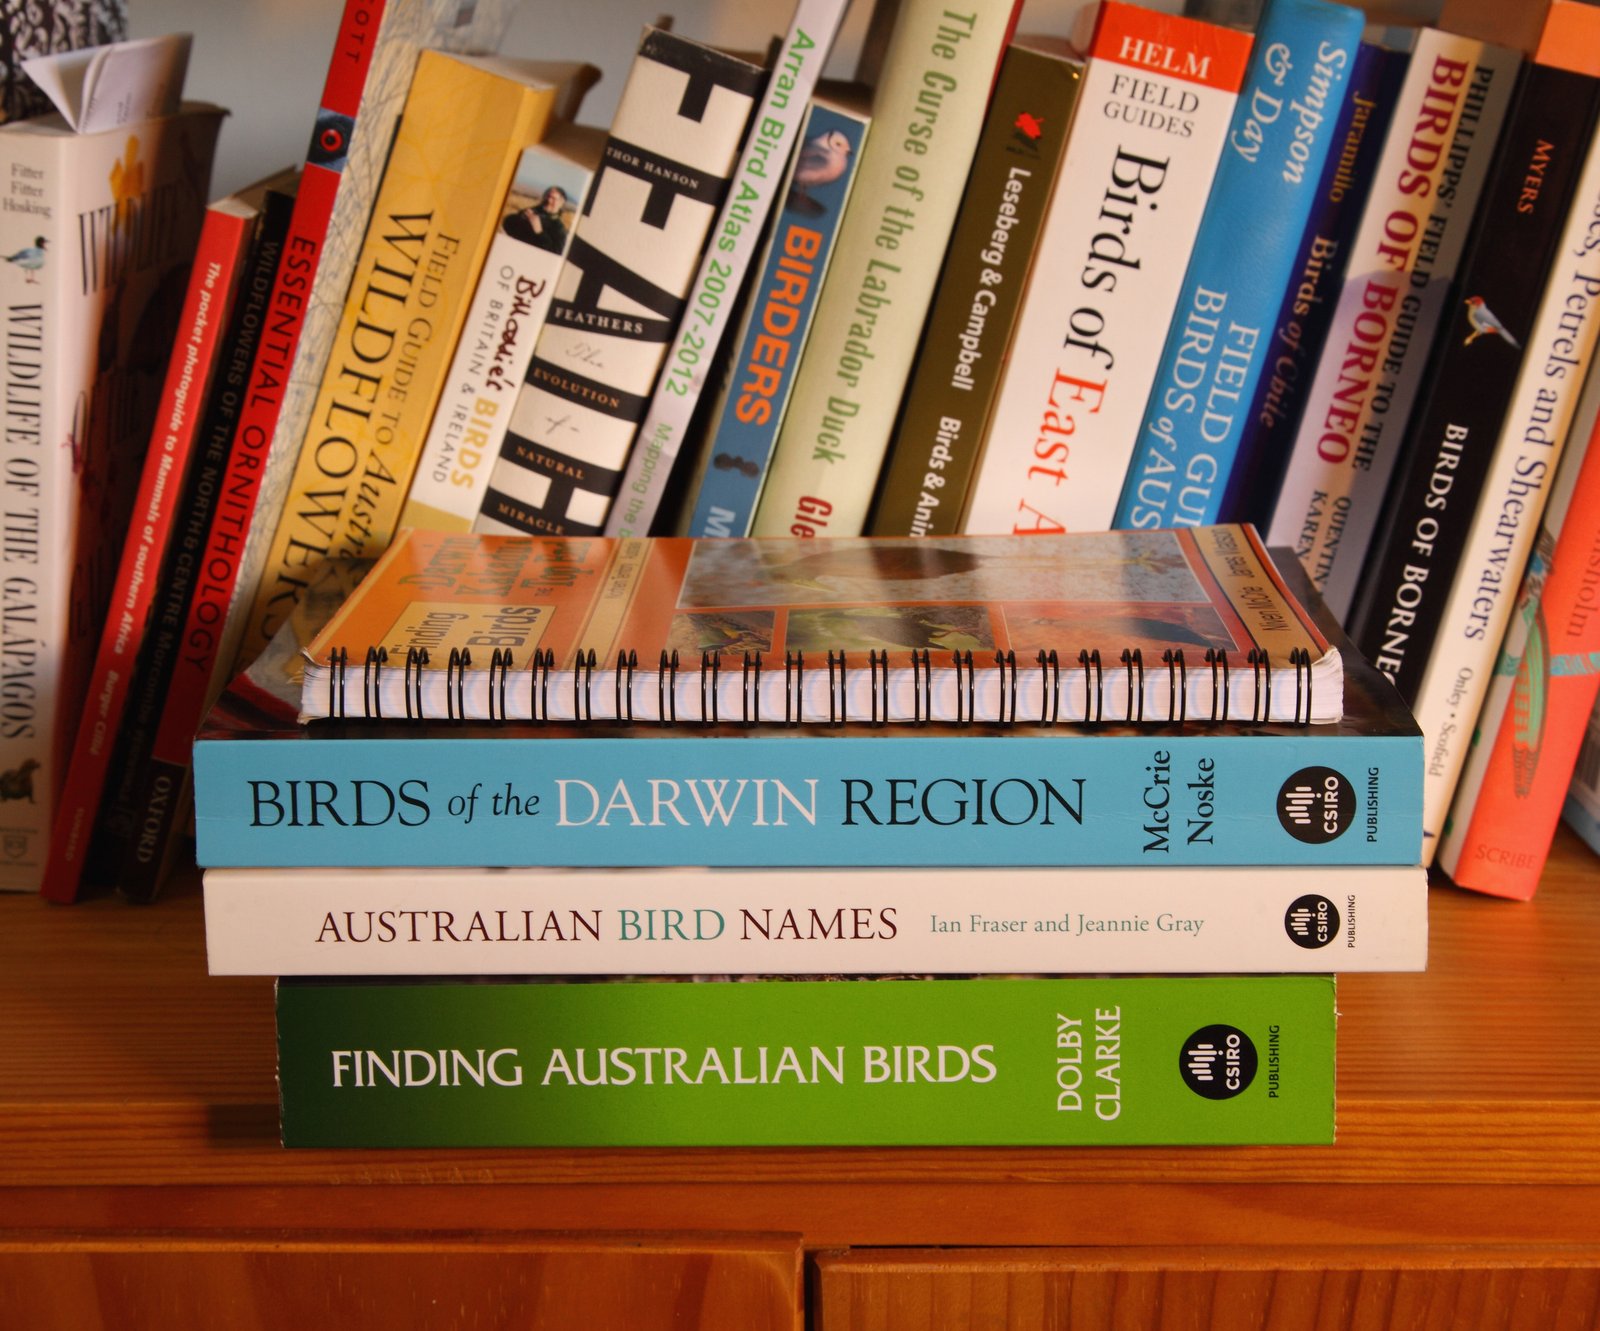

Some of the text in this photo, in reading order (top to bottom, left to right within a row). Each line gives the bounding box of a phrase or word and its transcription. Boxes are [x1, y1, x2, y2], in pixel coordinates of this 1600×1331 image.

[346, 0, 374, 64] OTT
[931, 9, 978, 60] The
[1119, 36, 1212, 80] HELM
[903, 70, 957, 156] Curse
[1103, 100, 1195, 138] GUIDES
[1109, 73, 1200, 114] FIELD
[1231, 43, 1292, 163] & Day
[1283, 41, 1347, 185] Simpson
[606, 146, 700, 190] THOR HANSON
[892, 165, 924, 202] of
[1329, 91, 1376, 203] Jaramillo
[1517, 139, 1555, 214] MYERS
[665, 28, 815, 397] Arran Bird Atlas 2007-2012
[875, 205, 915, 250] the
[1081, 144, 1170, 293] Birds
[952, 167, 1031, 391] Leseberg & Campbell
[1317, 54, 1469, 464] BIRDS OF BORNEO
[1409, 213, 1448, 289] FIELD
[228, 241, 279, 385] WILDFLOWERS
[555, 306, 644, 334] FEATHERS
[735, 225, 823, 426] BIRDERS
[837, 258, 902, 388] Labrador
[1063, 307, 1114, 370] of
[1164, 284, 1227, 413] BIRDS
[1259, 234, 1338, 428] Birds of Chile
[1382, 292, 1422, 375] GUIDE
[1545, 270, 1600, 379] Petrels
[222, 391, 237, 419] OF
[433, 264, 516, 483] OF BRITAIN & IRELAND
[533, 367, 620, 409] EVOLUTION
[1200, 321, 1260, 443] FIELD
[1370, 381, 1398, 412] TO
[184, 235, 317, 673] ESSENTIAL ORNITHOLOGY
[207, 424, 229, 462] THE
[376, 411, 402, 446] TO
[450, 397, 498, 489] BIRDS
[811, 395, 861, 465] Duck
[929, 416, 963, 470] Birds
[1028, 368, 1108, 486] East
[1150, 416, 1177, 453] of
[1352, 418, 1384, 471] THE
[1524, 388, 1559, 447] and
[114, 262, 222, 655] The pocket photoguide to Mammals of southern Africa
[516, 446, 585, 480] NATURAL
[631, 422, 673, 496] Mapping
[923, 471, 946, 490] &
[1, 303, 47, 740] WILDLIFE OF THE GALÁPAGOS
[498, 503, 564, 536] MIRACLE
[624, 496, 646, 525] the
[1297, 489, 1328, 560] KAREN
[1314, 495, 1352, 585] QUENTIN
[1375, 422, 1470, 687] BIRDS OF BORNE
[1464, 455, 1548, 641] Shearwaters
[465, 606, 542, 648] Birds
[1428, 667, 1474, 778] Onley Scofield
[137, 776, 172, 863] OXFORD
[247, 778, 1087, 827] BIRDS of the DARWIN REGION
[1142, 750, 1171, 854] McCrie
[1186, 757, 1215, 846] Noske
[1323, 776, 1339, 834] CSIRO
[1367, 767, 1379, 843] PUBLISHING
[1475, 842, 1539, 869] SCRIBE
[314, 907, 898, 943] AUSTRALIAN BIRD NAMES
[930, 913, 1205, 937] Ian Fraser and Jeannie Gray
[1316, 900, 1329, 943] CSIRO
[1347, 894, 1356, 948] PUBLISHING
[331, 1044, 998, 1087] FINDING AUSTRALIAN BIRDS
[1056, 1012, 1082, 1112] DOLBY
[1095, 1005, 1121, 1121] CLARKE
[1226, 1034, 1241, 1090] CSIRO
[1268, 1025, 1280, 1099] PUBLISHING
